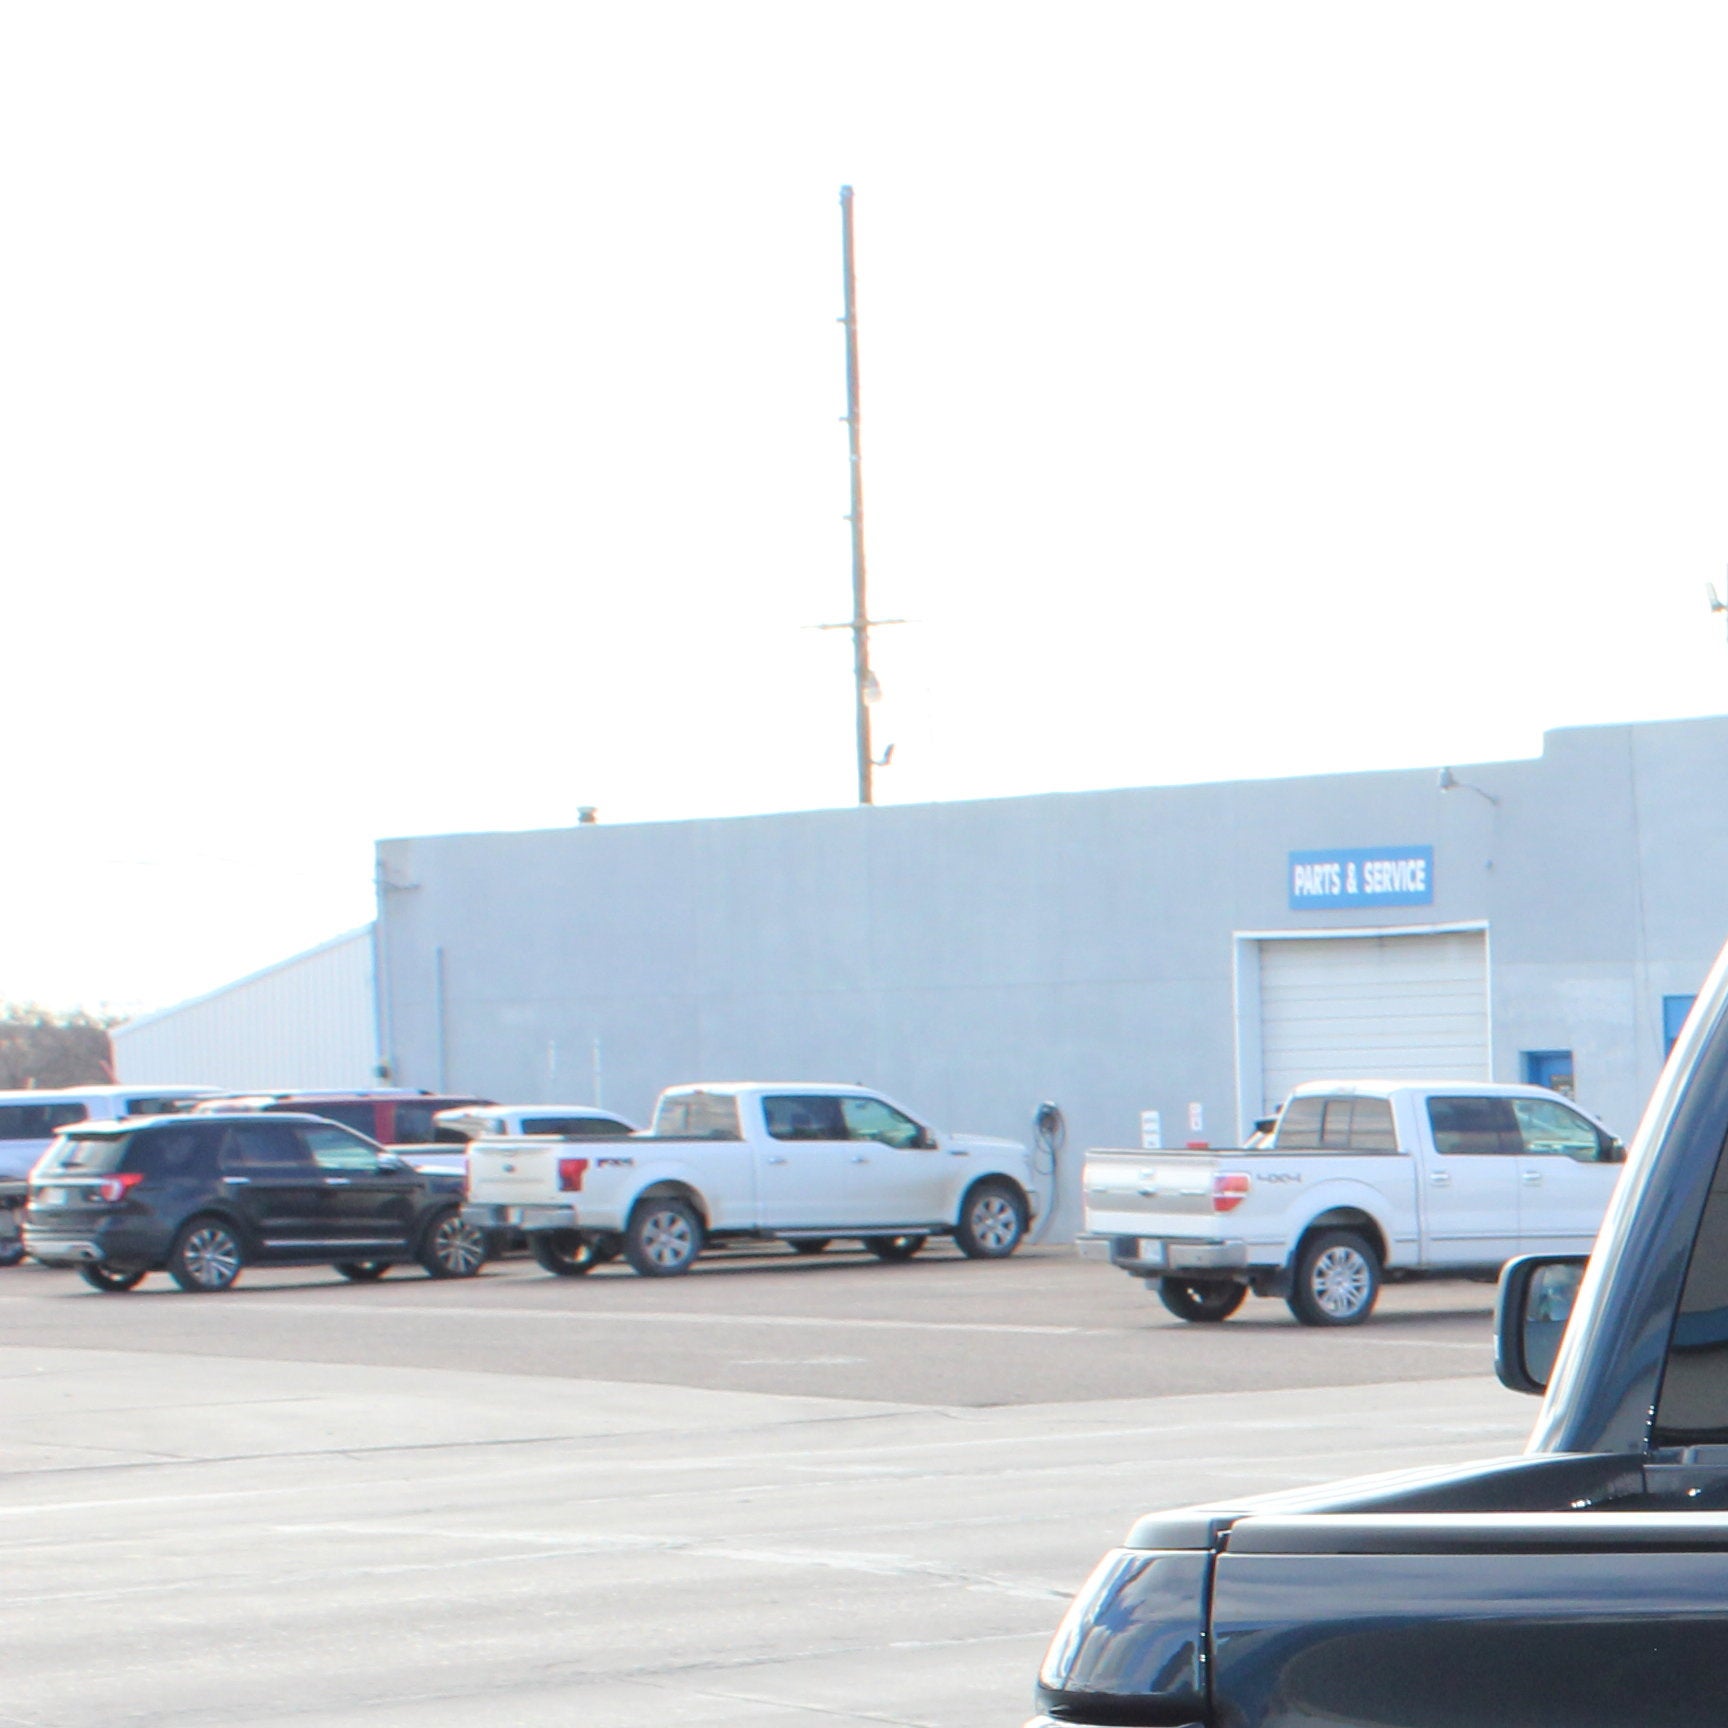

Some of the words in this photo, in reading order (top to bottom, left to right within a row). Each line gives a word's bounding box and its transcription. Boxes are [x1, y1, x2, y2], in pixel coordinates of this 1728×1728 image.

[1294, 863, 1340, 896] PARTS
[1346, 862, 1359, 894] &
[1363, 859, 1427, 893] SERVICE
